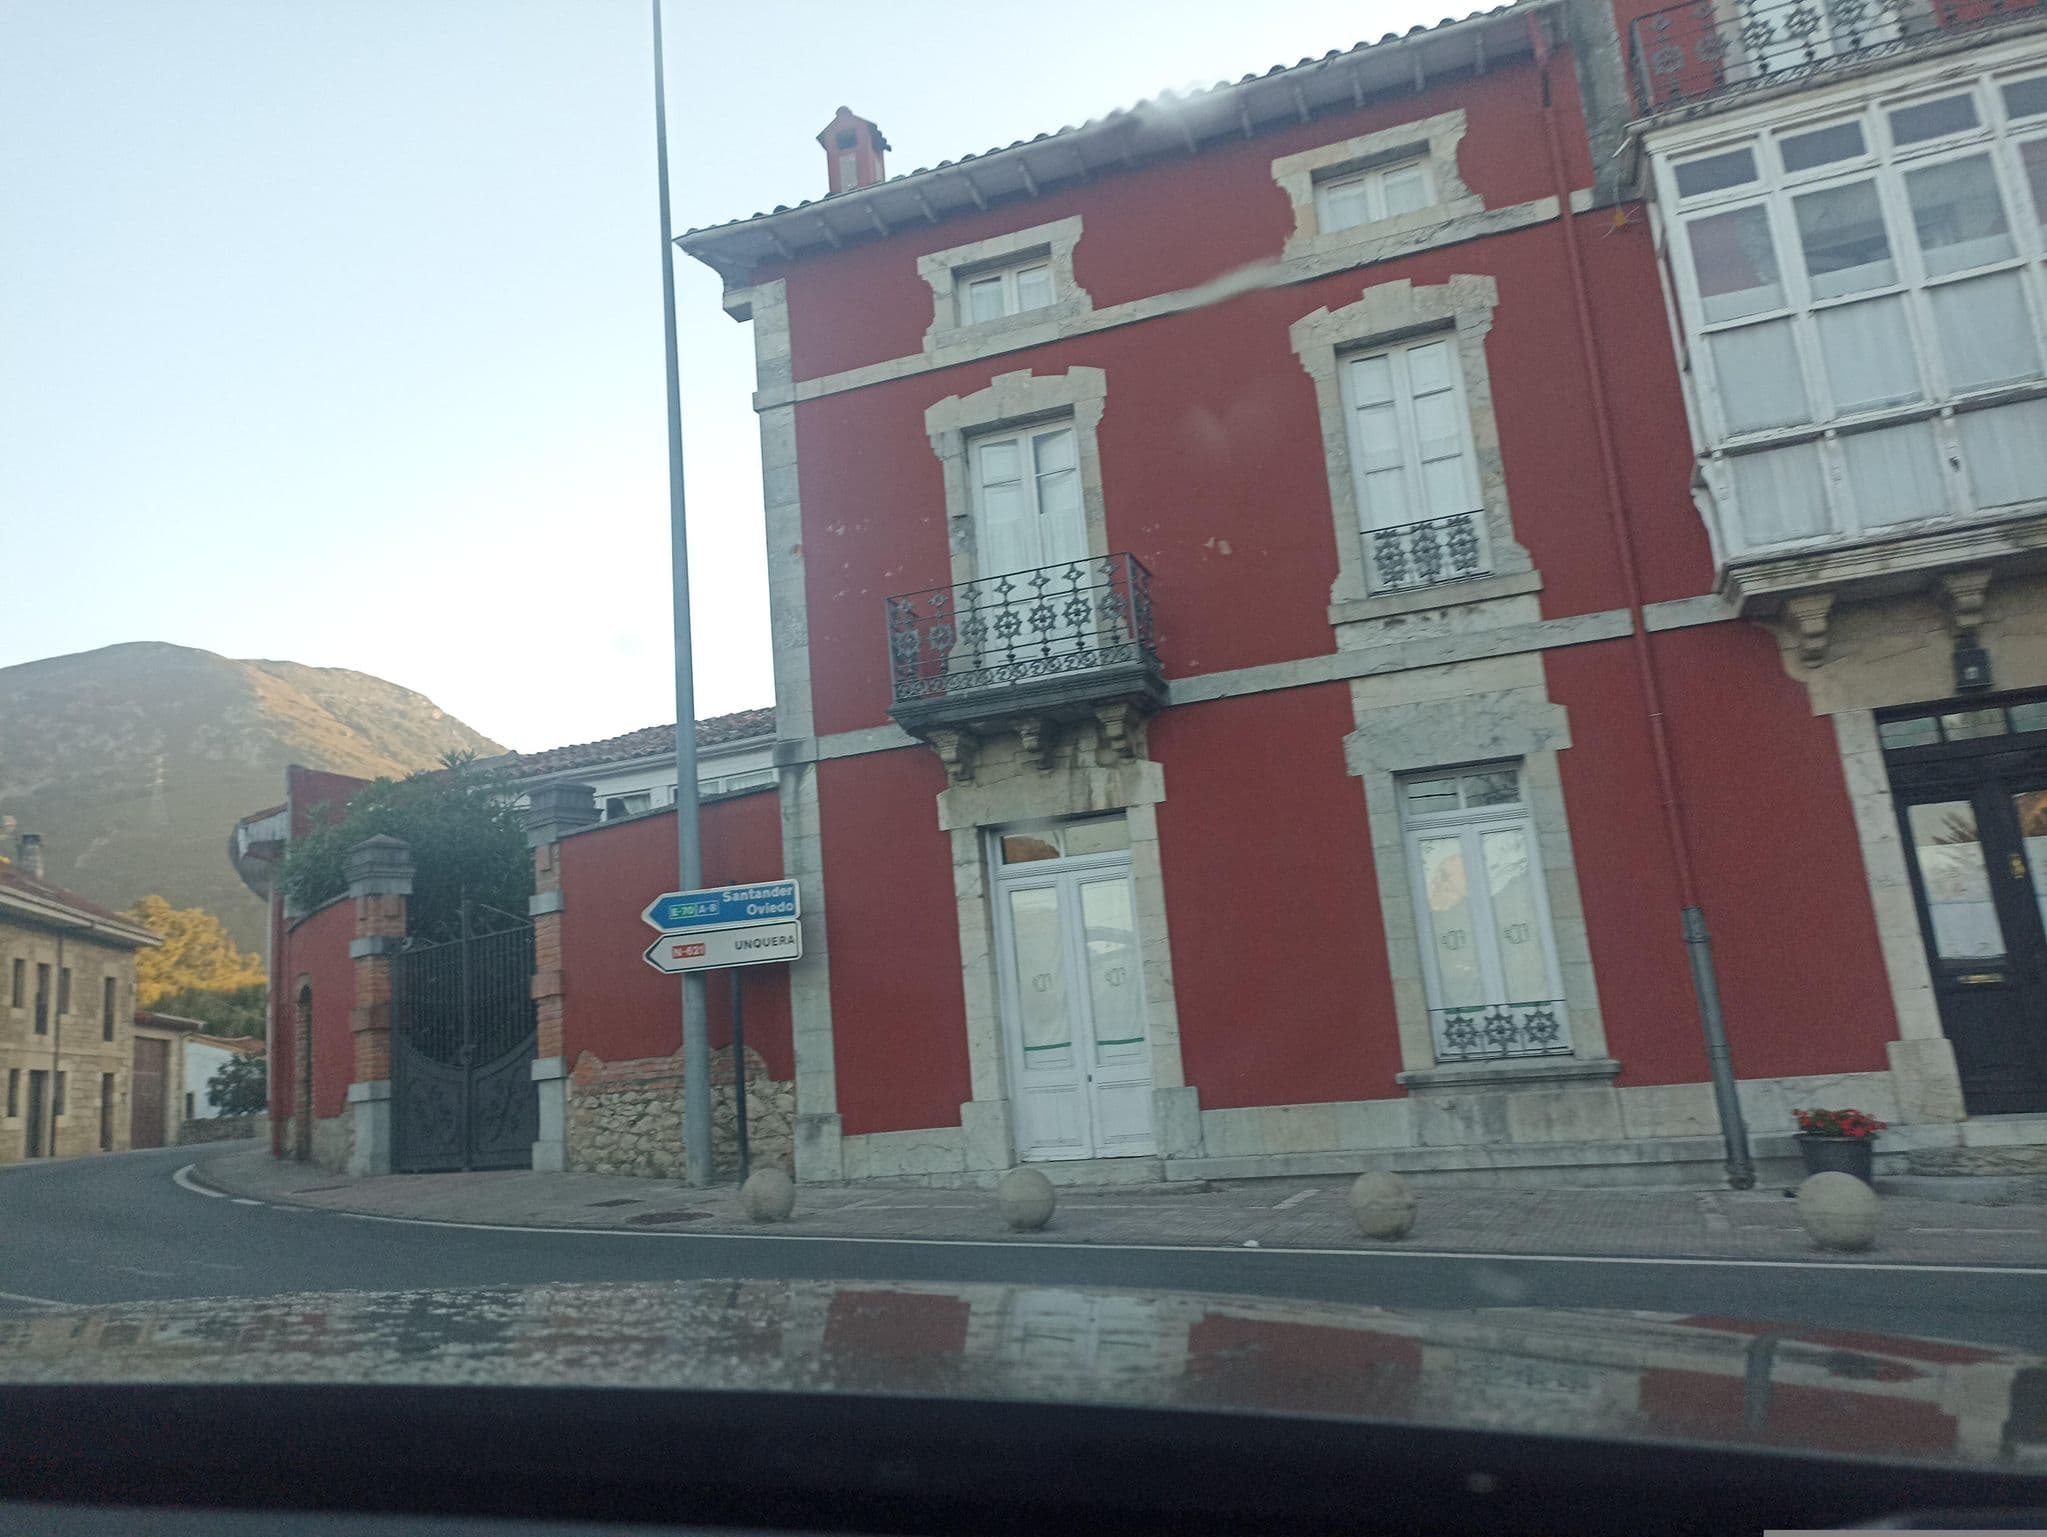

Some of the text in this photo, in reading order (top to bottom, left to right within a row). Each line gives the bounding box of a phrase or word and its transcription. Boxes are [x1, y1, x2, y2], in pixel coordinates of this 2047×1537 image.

[722, 885, 794, 902] Santander
[671, 905, 695, 917] E-70
[746, 901, 794, 916] Oviedo
[734, 935, 795, 950] UNQUERA
